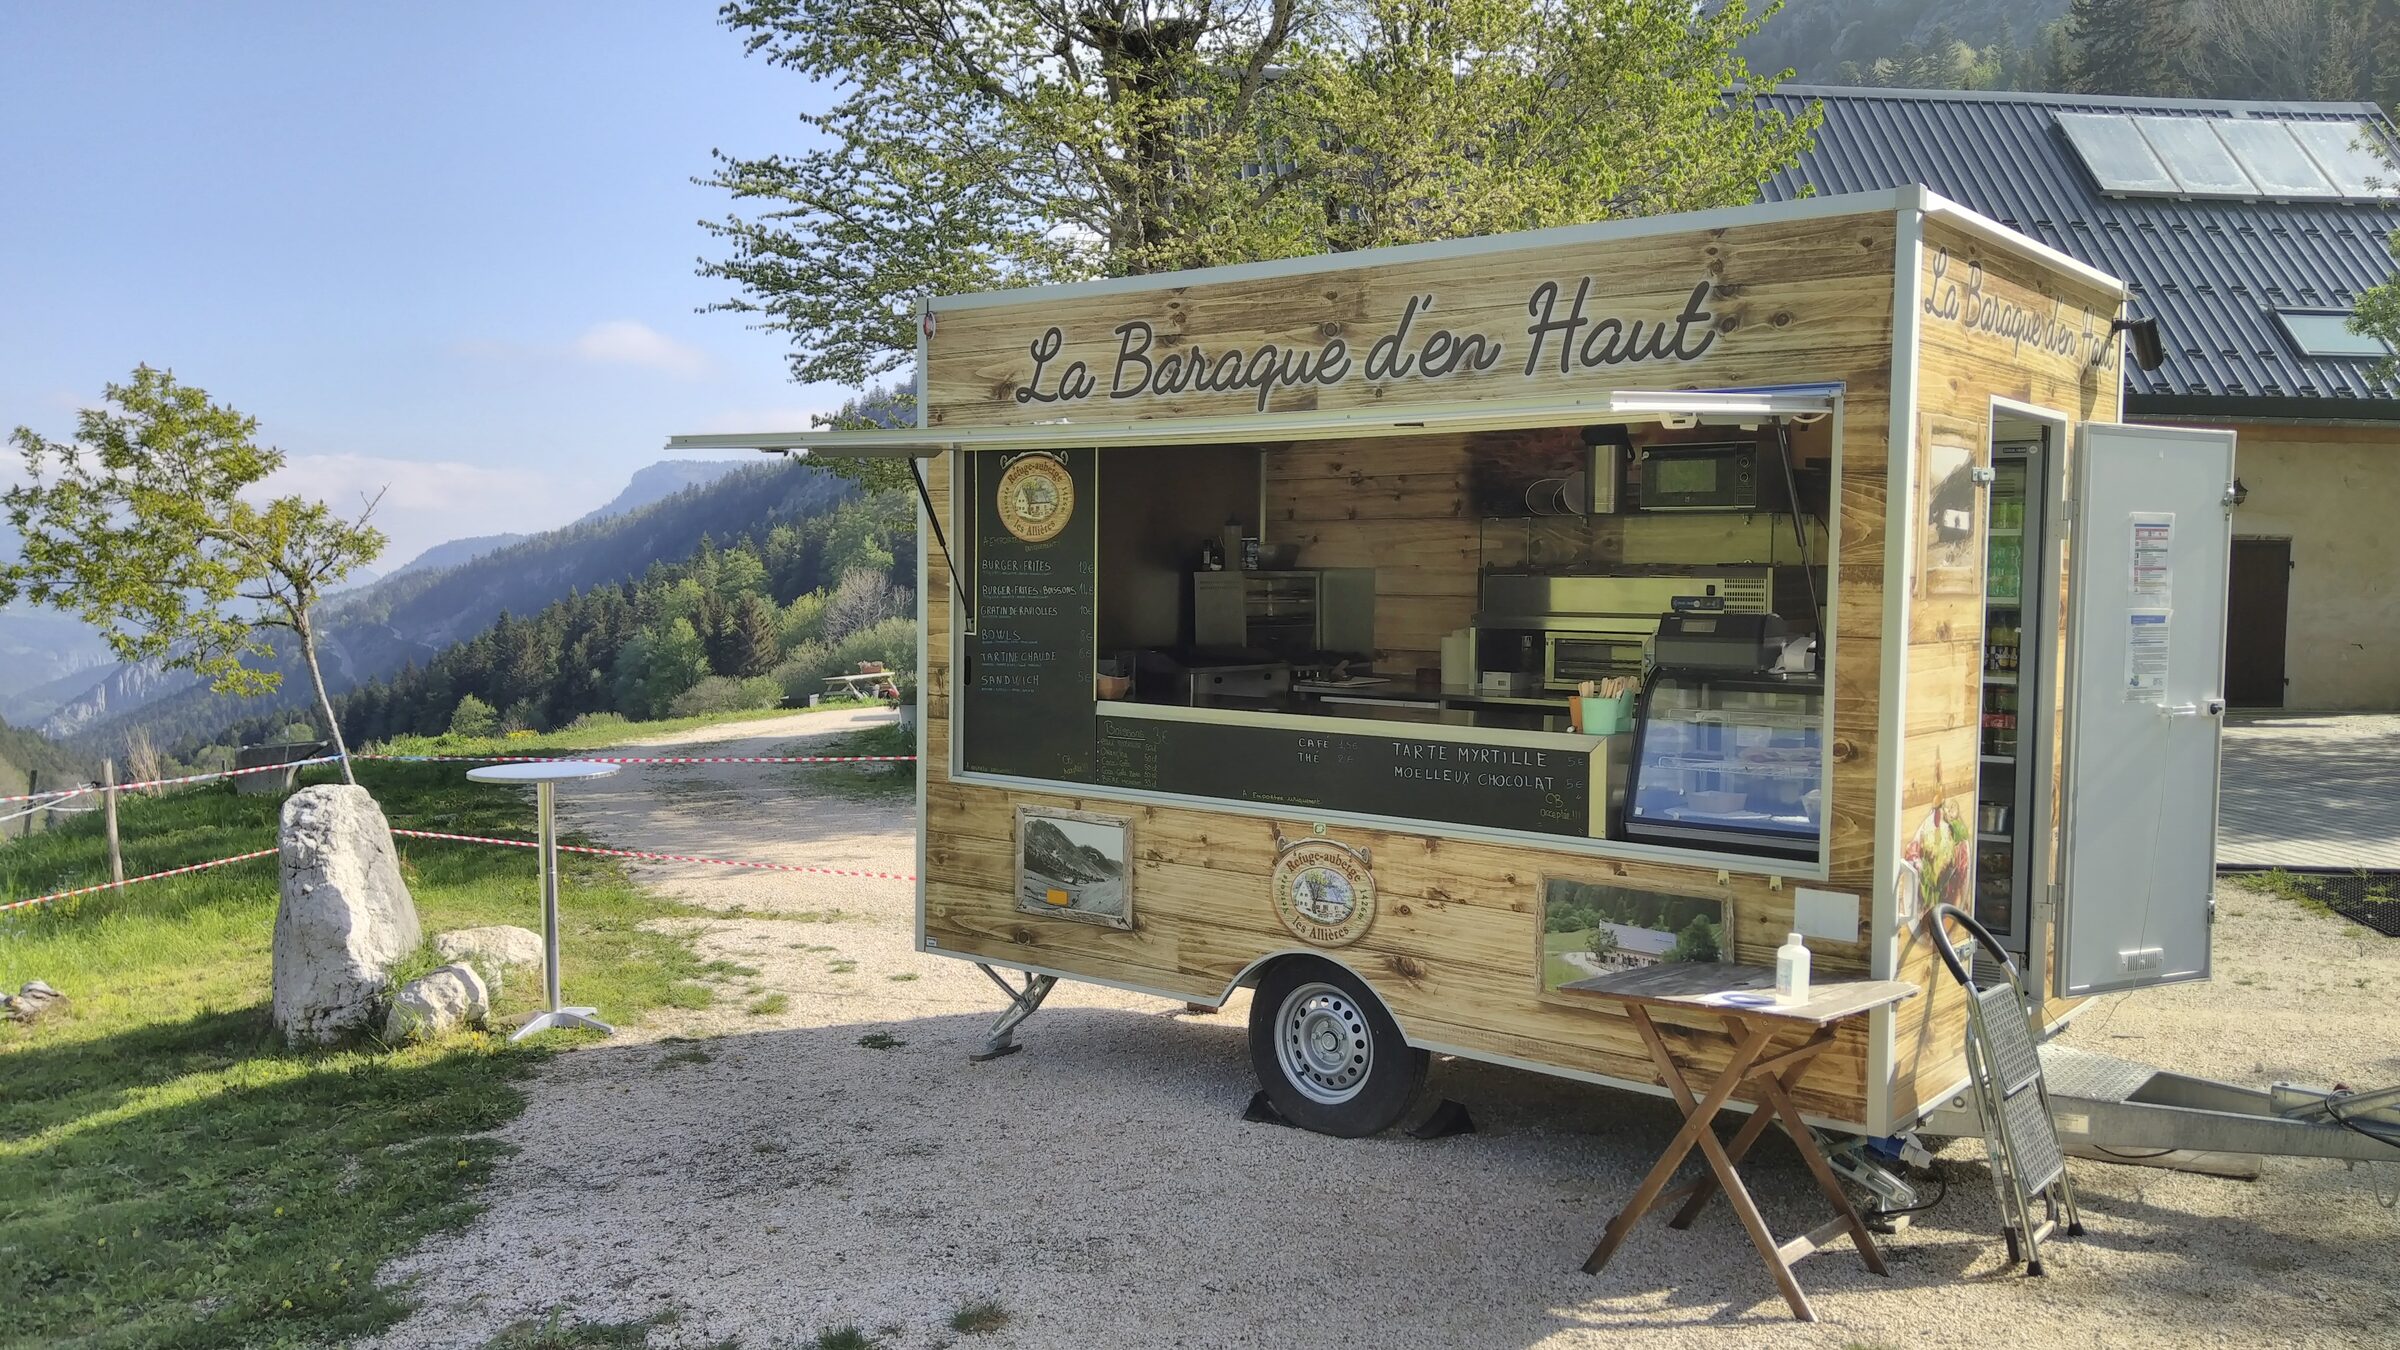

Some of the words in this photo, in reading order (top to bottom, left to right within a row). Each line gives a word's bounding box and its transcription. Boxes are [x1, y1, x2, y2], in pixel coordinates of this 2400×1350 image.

[1925, 247, 1960, 321] La
[1965, 261, 2043, 358] Baraque
[2045, 296, 2076, 356] d'en
[2081, 305, 2115, 371] Haut
[1017, 327, 1095, 403] La
[1111, 321, 1351, 412] Baraque
[1366, 295, 1500, 381] d'en
[1525, 276, 1716, 377] Haut
[982, 559, 1019, 571] BURGER
[1023, 559, 1052, 572] FRITES
[982, 584, 1011, 595] BURGER
[1014, 585, 1039, 595] FRITES
[980, 605, 1008, 616] GRATIN
[1009, 606, 1018, 616] DE
[981, 628, 1021, 640] BOWLS
[981, 651, 1019, 662] TARTINE
[1020, 651, 1057, 661] CHAUDE
[981, 675, 1040, 686] SANDWICH
[1298, 735, 1329, 749] CAFÉ
[1297, 750, 1320, 763] THÉ
[1392, 742, 1448, 761] TARTE
[1458, 748, 1549, 767] MYRTILLE
[1567, 756, 1585, 768] 5€
[1394, 766, 1471, 784] MOELLEUX
[1478, 773, 1555, 793] CHOCOLAT
[1566, 778, 1584, 790] 5€
[1286, 851, 1361, 883] Refuge-auberge
[1291, 915, 1307, 934] les
[1309, 926, 1350, 941] Allières
